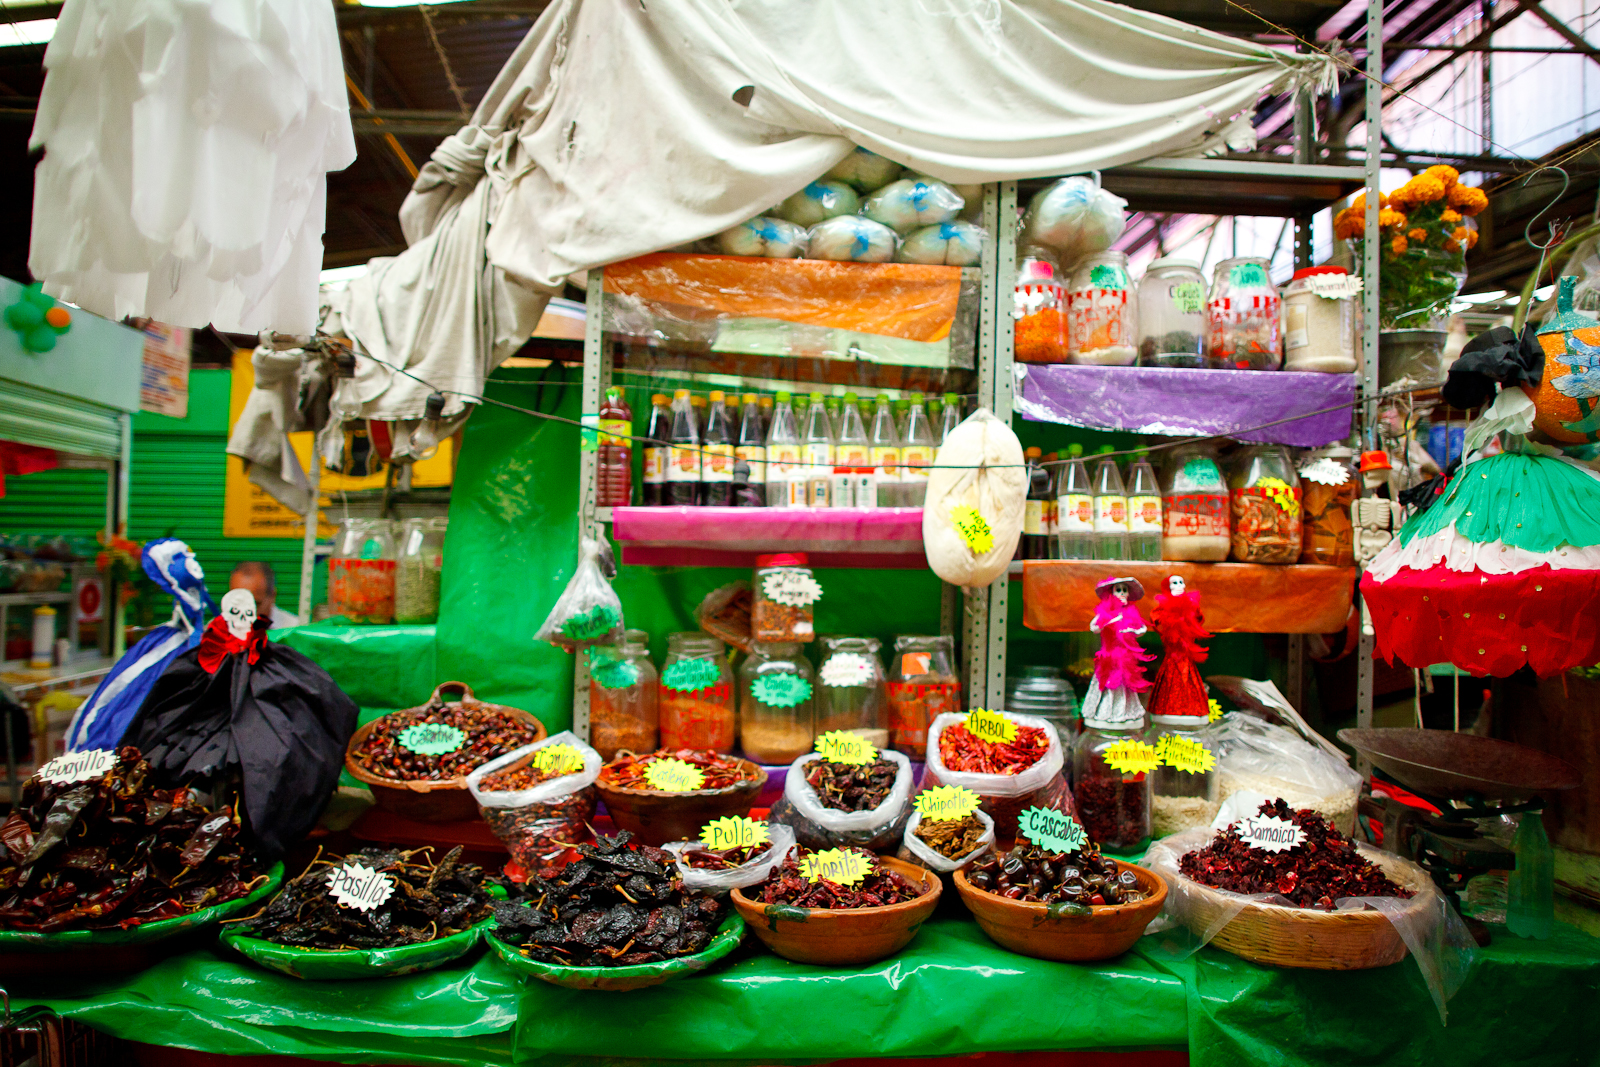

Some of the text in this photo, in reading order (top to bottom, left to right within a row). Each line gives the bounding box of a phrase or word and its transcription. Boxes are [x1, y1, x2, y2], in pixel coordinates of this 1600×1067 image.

[921, 791, 969, 815] Chipotle
[713, 820, 753, 846] Pulla
[1029, 811, 1082, 845] Cascabel
[1242, 817, 1296, 844] Jamaica
[332, 869, 388, 904] Pasilla
